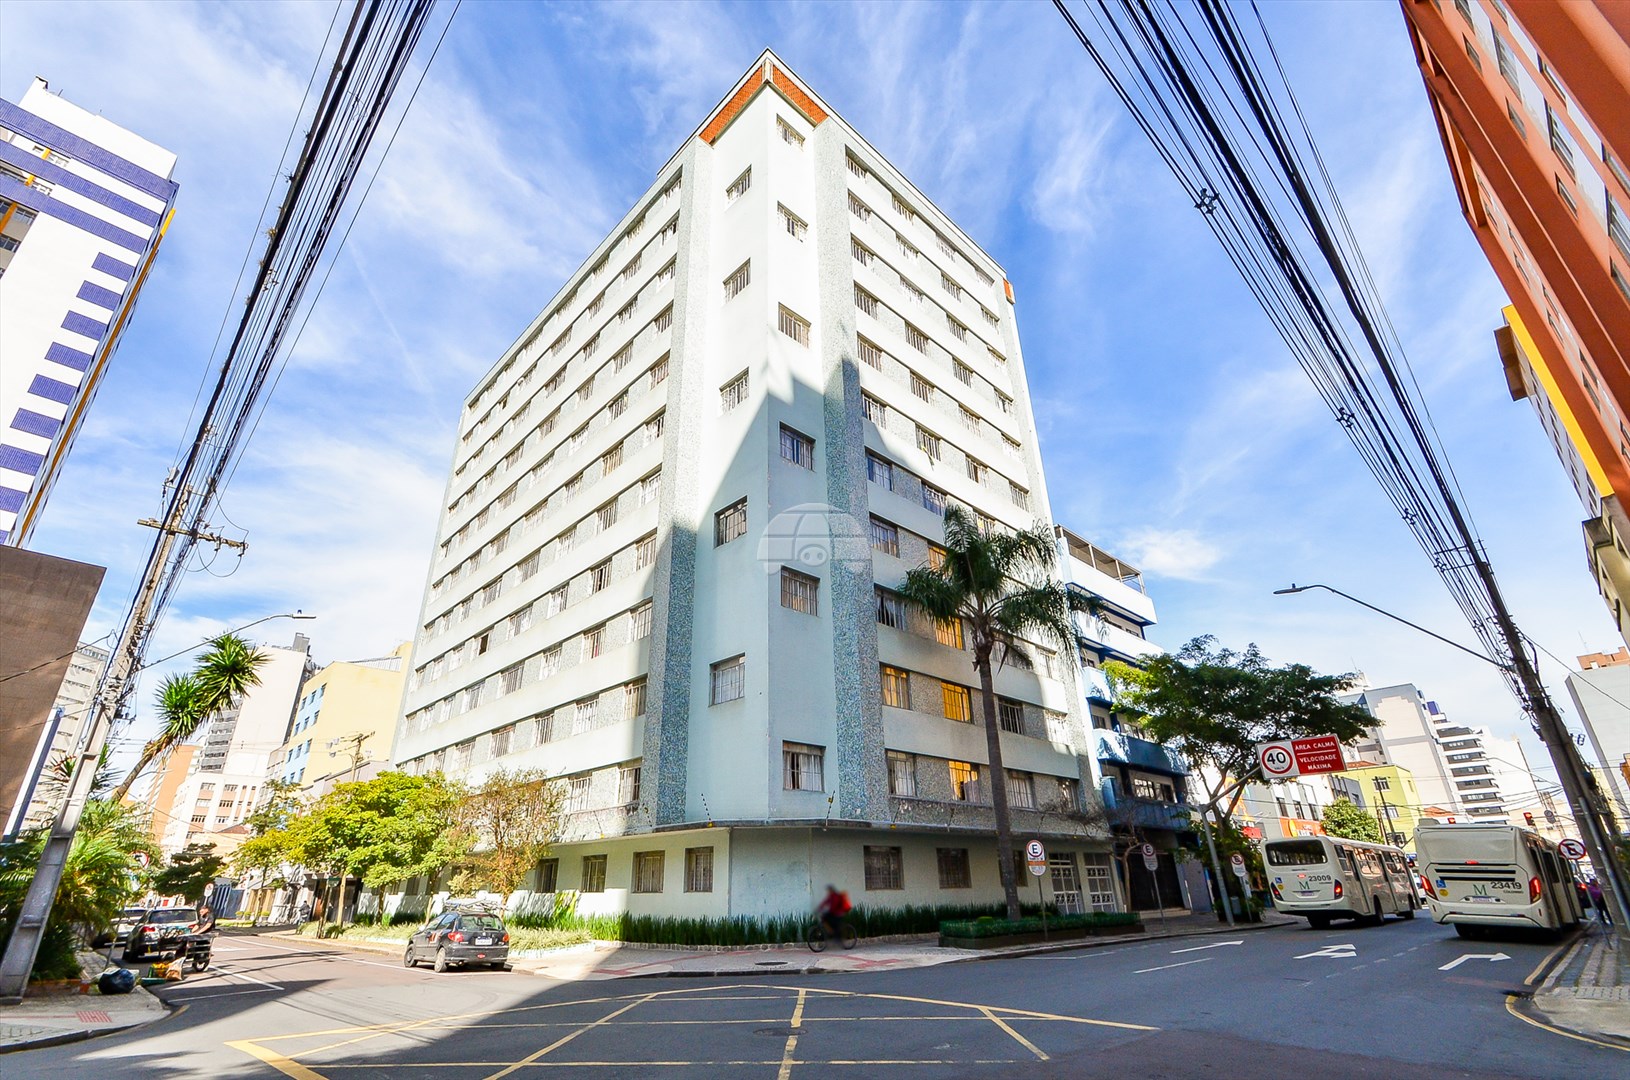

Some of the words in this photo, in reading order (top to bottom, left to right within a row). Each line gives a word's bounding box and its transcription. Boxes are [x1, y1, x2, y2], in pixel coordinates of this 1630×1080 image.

[1313, 741, 1335, 749] CALMA
[1267, 752, 1286, 764] 40
[1300, 755, 1337, 763] VELOCIDADE
[1031, 844, 1038, 854] E
[1145, 845, 1152, 853] E
[1299, 881, 1310, 890] M
[1491, 881, 1522, 889] 23419
[1473, 884, 1487, 896] M
